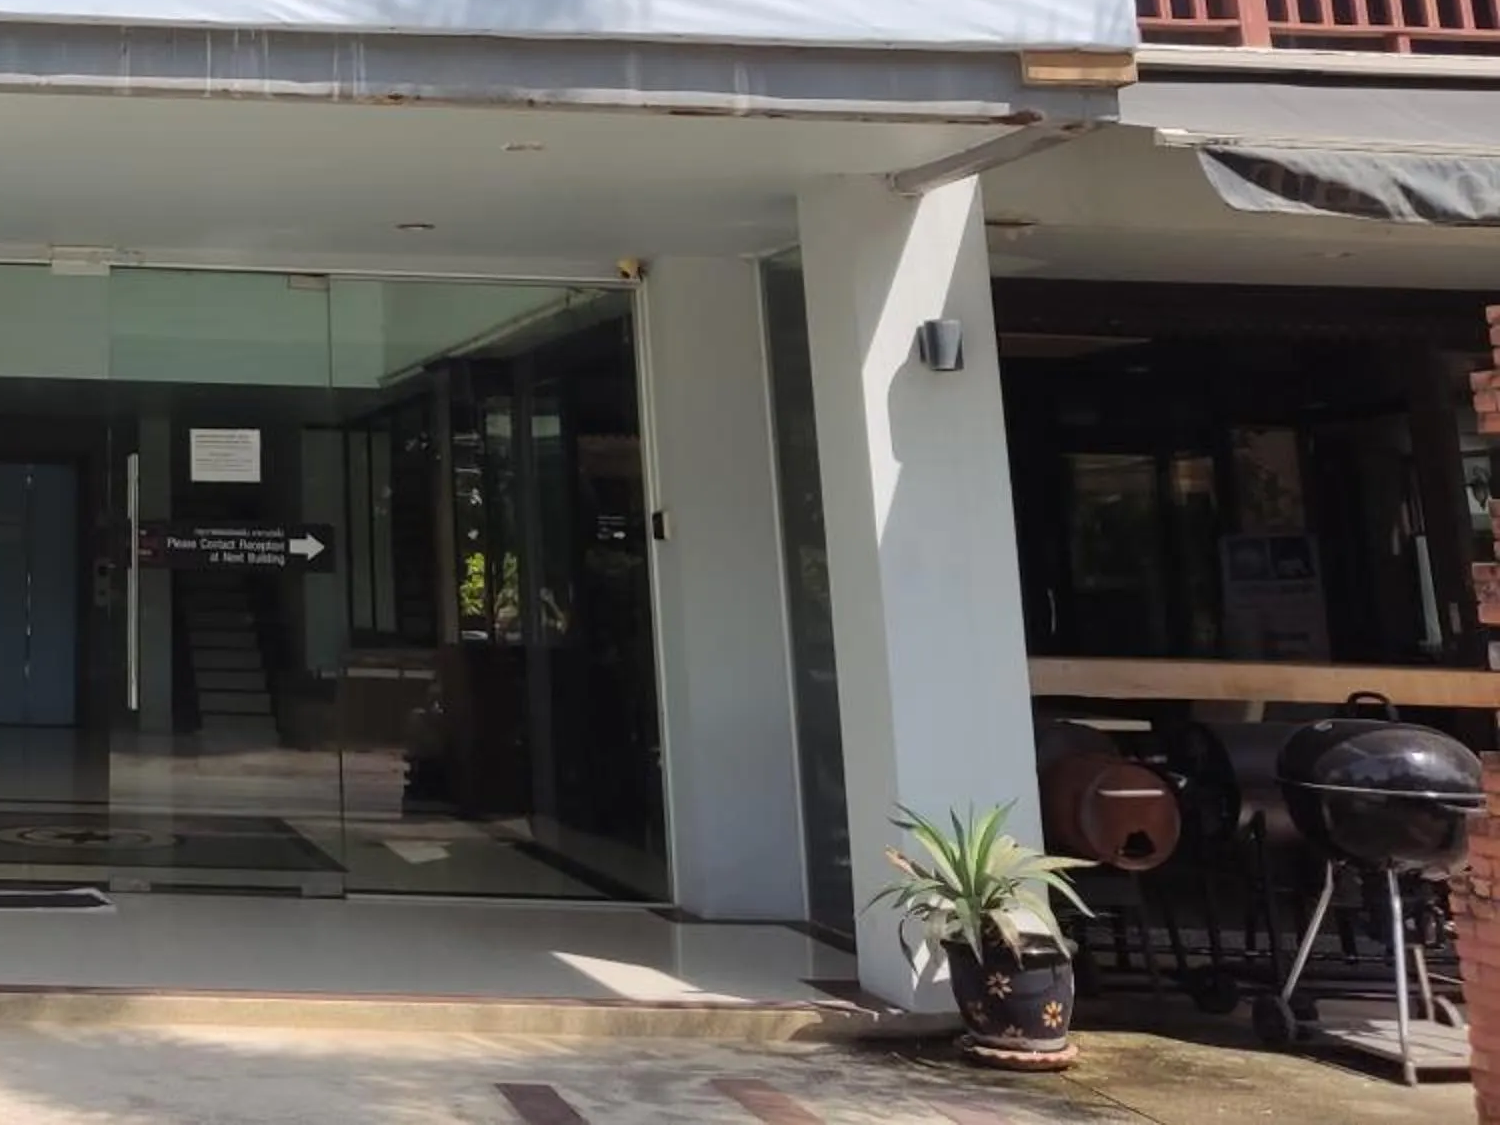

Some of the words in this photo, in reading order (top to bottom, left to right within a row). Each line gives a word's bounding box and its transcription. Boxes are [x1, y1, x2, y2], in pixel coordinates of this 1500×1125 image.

[167, 537, 197, 549] Please
[201, 539, 235, 550] Contact
[240, 539, 285, 552] Reception
[248, 552, 285, 567] Building
